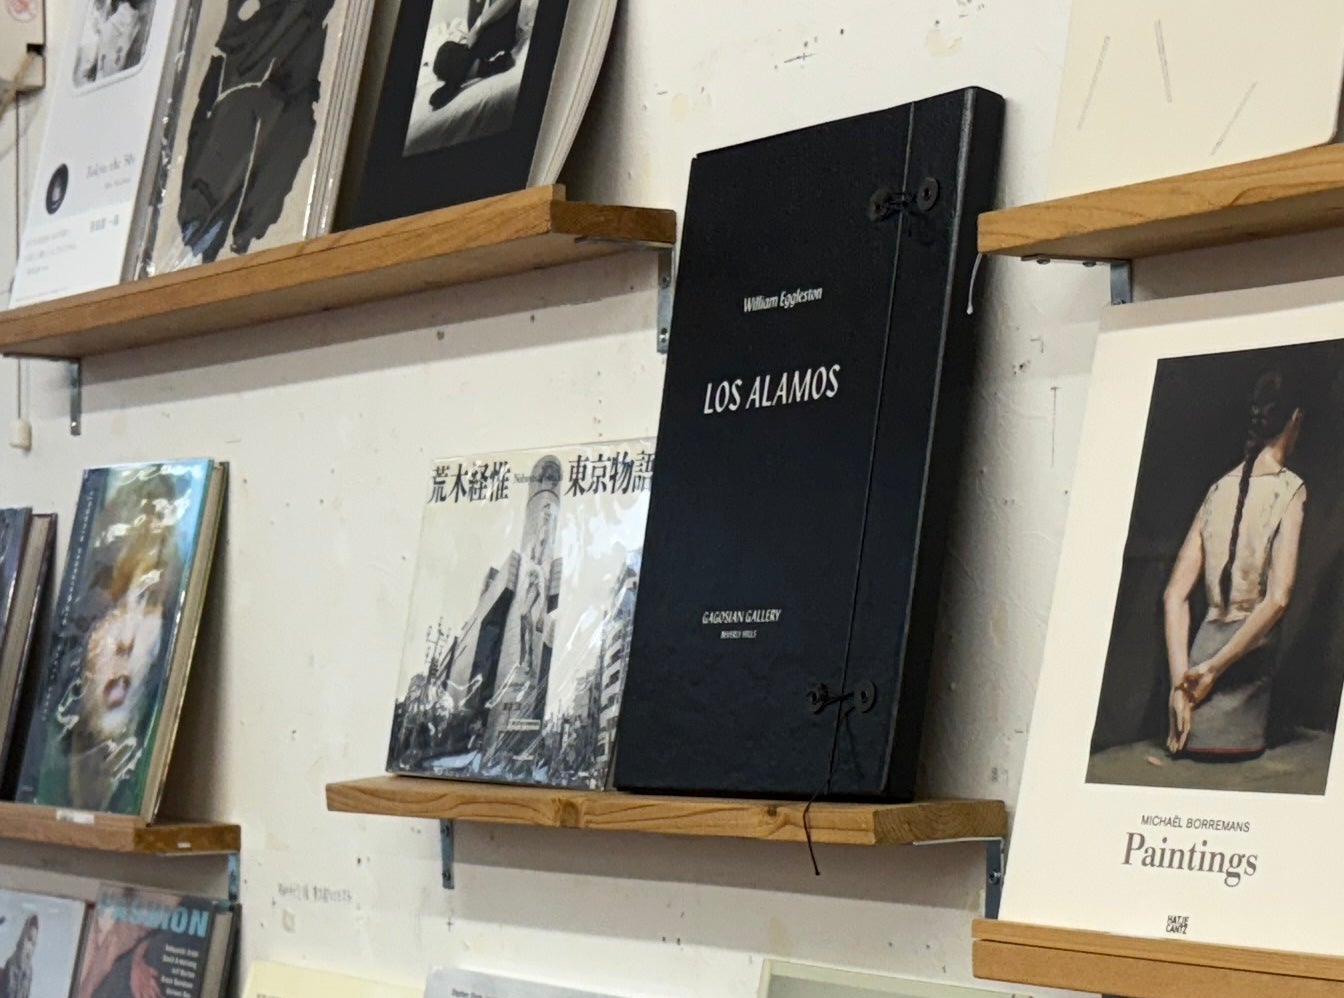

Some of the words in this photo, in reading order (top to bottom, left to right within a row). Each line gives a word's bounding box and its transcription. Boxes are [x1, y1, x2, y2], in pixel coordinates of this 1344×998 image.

[744, 295, 779, 313] William
[780, 287, 823, 309] Eggleston
[704, 379, 743, 414] LOS
[745, 363, 841, 410] ALAMOS
[427, 461, 511, 504] 荒木経惟
[564, 450, 655, 497] 東京物語
[702, 610, 745, 625] GAGOSIAN
[745, 608, 782, 623] GALLERY
[1141, 815, 1183, 829] MICHAËL
[1186, 817, 1251, 833] BORREMANS
[1121, 831, 1258, 888] Paintings
